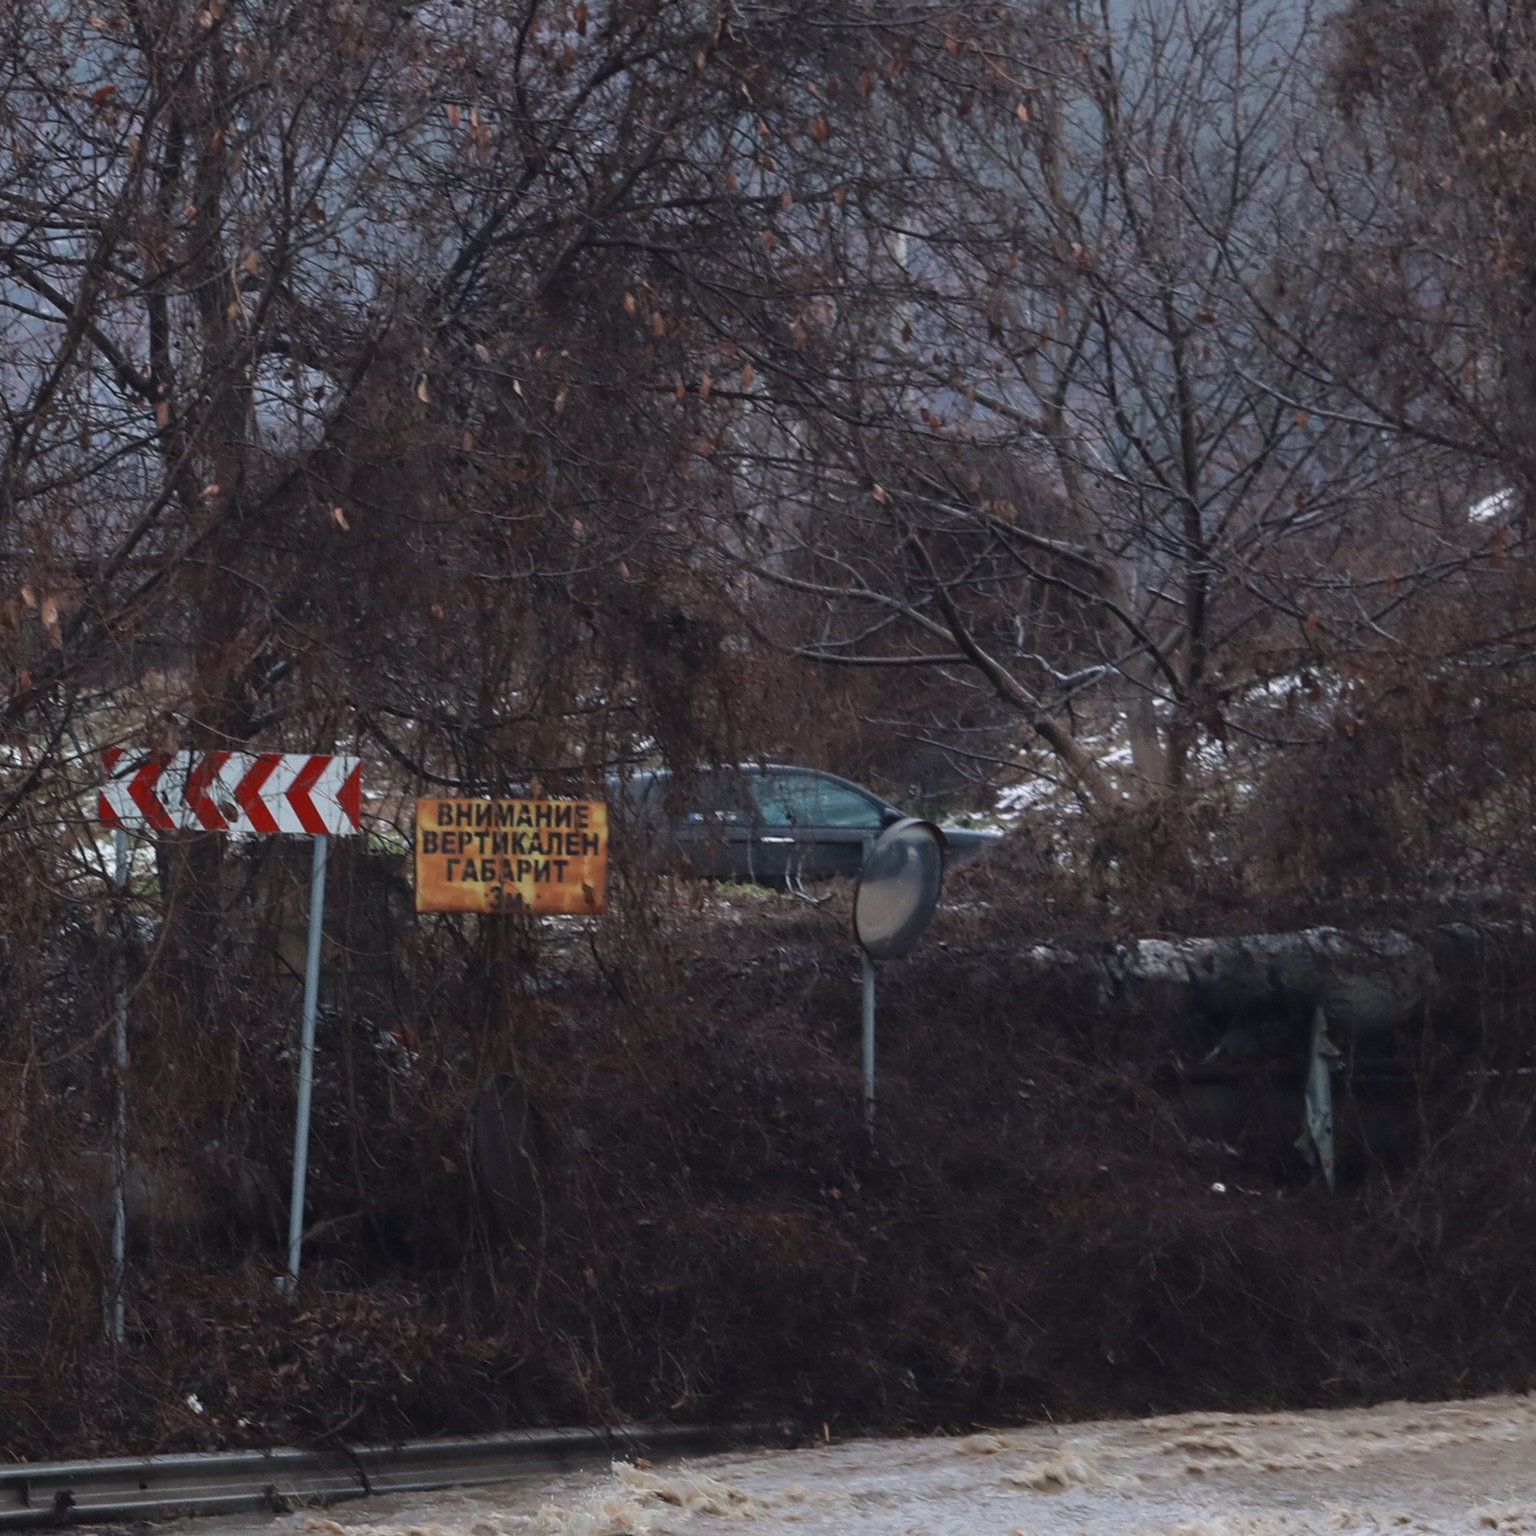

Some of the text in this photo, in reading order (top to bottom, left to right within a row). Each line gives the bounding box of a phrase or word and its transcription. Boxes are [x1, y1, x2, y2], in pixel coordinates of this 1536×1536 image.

[437, 802, 590, 829] ВНИМАНИЕ
[422, 831, 600, 856] ВЕРТИКАЛЕН
[446, 858, 570, 883] ГАБАРИТ
